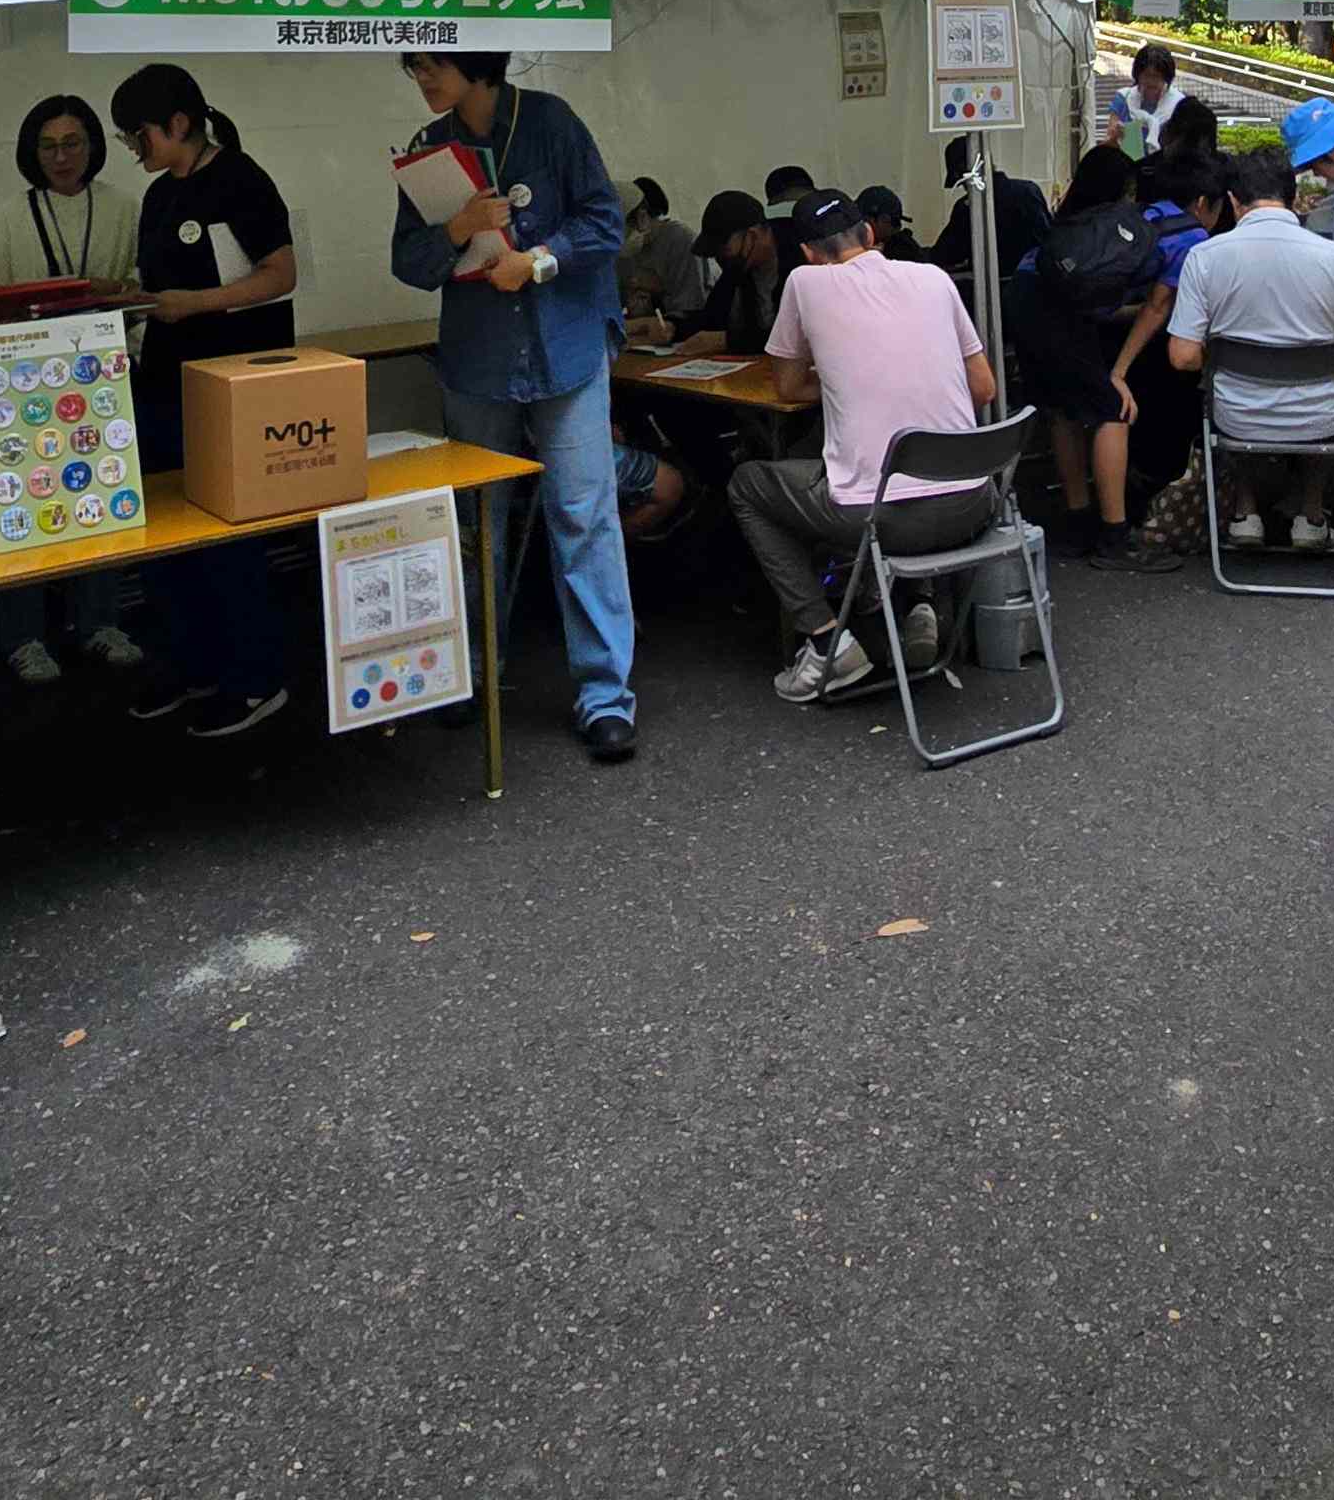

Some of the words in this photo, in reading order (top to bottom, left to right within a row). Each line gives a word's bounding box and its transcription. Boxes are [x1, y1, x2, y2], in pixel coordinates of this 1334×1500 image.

[276, 20, 458, 45] 東京都現代美術館
